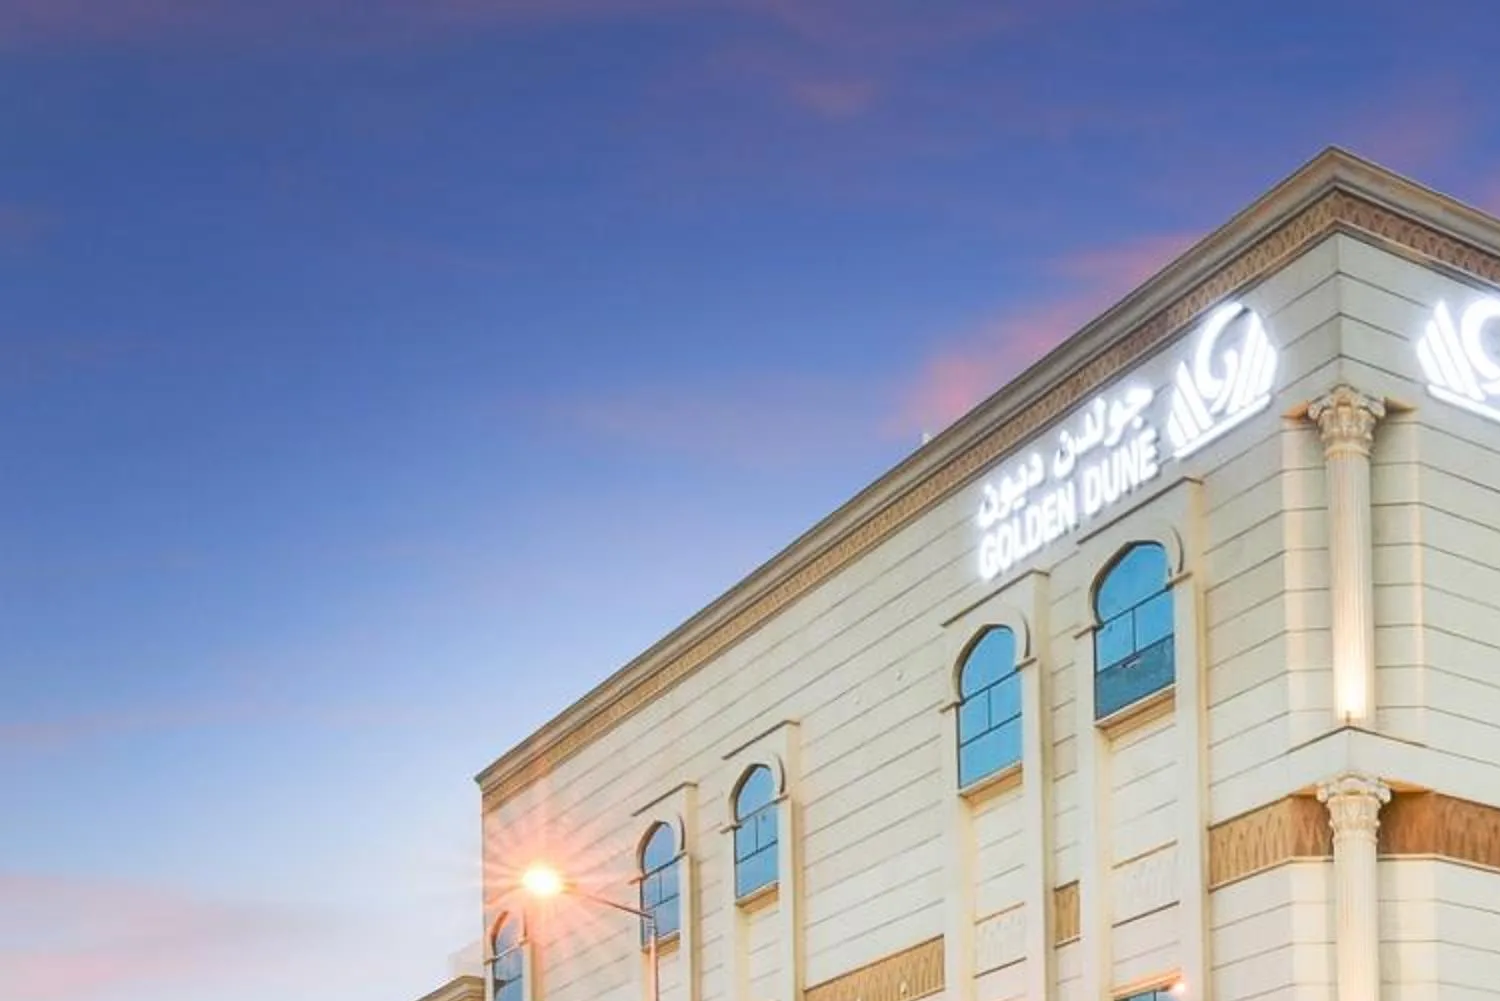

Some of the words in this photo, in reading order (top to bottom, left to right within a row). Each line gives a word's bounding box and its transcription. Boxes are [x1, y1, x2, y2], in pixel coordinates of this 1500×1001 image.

[1053, 386, 1153, 478] جولدن
[977, 451, 1044, 529] ديون
[979, 480, 1077, 581] GOLDEN
[1083, 426, 1158, 516] DUNE
